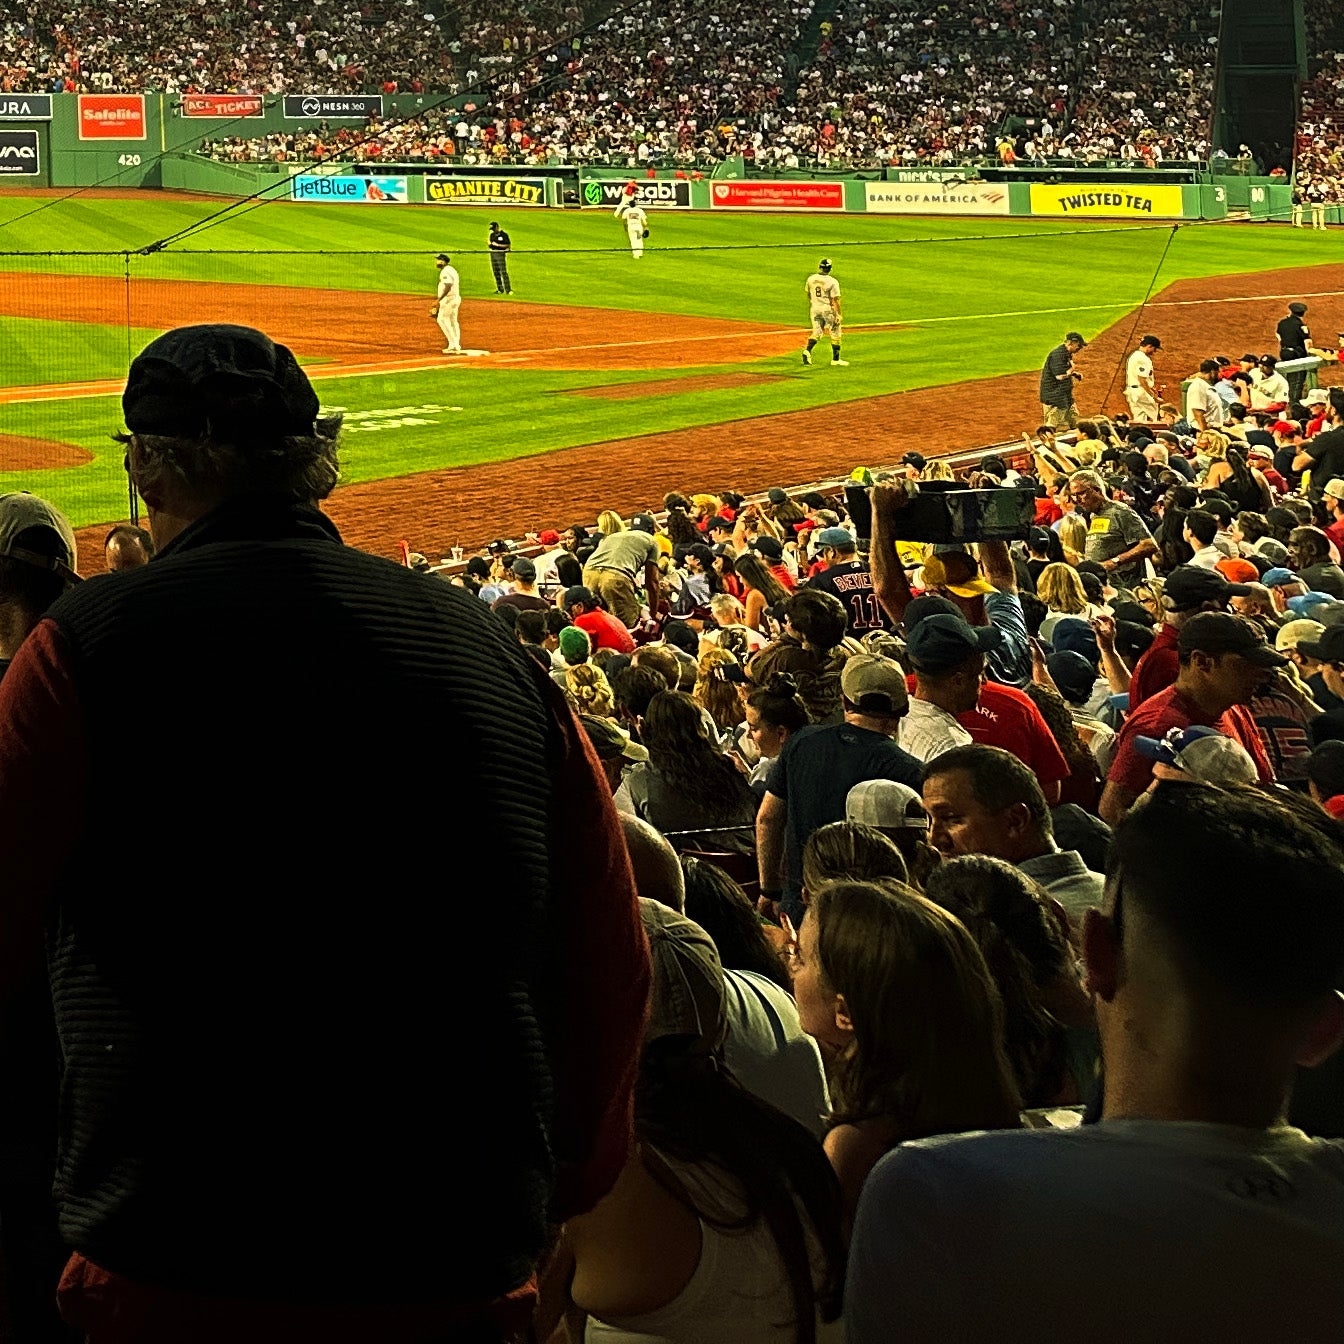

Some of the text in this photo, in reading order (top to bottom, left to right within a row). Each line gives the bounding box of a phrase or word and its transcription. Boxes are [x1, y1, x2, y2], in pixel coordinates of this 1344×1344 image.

[83, 108, 141, 122] Safelite
[323, 102, 350, 112] NESN
[118, 154, 141, 166] 420
[299, 178, 357, 198] jetBlue
[429, 180, 544, 201] GRANITE CITY
[603, 182, 676, 200] wsabi
[869, 193, 978, 204] BANK OF AMERICA
[1058, 193, 1153, 213] TWISTED TEA
[850, 593, 884, 629] 11
